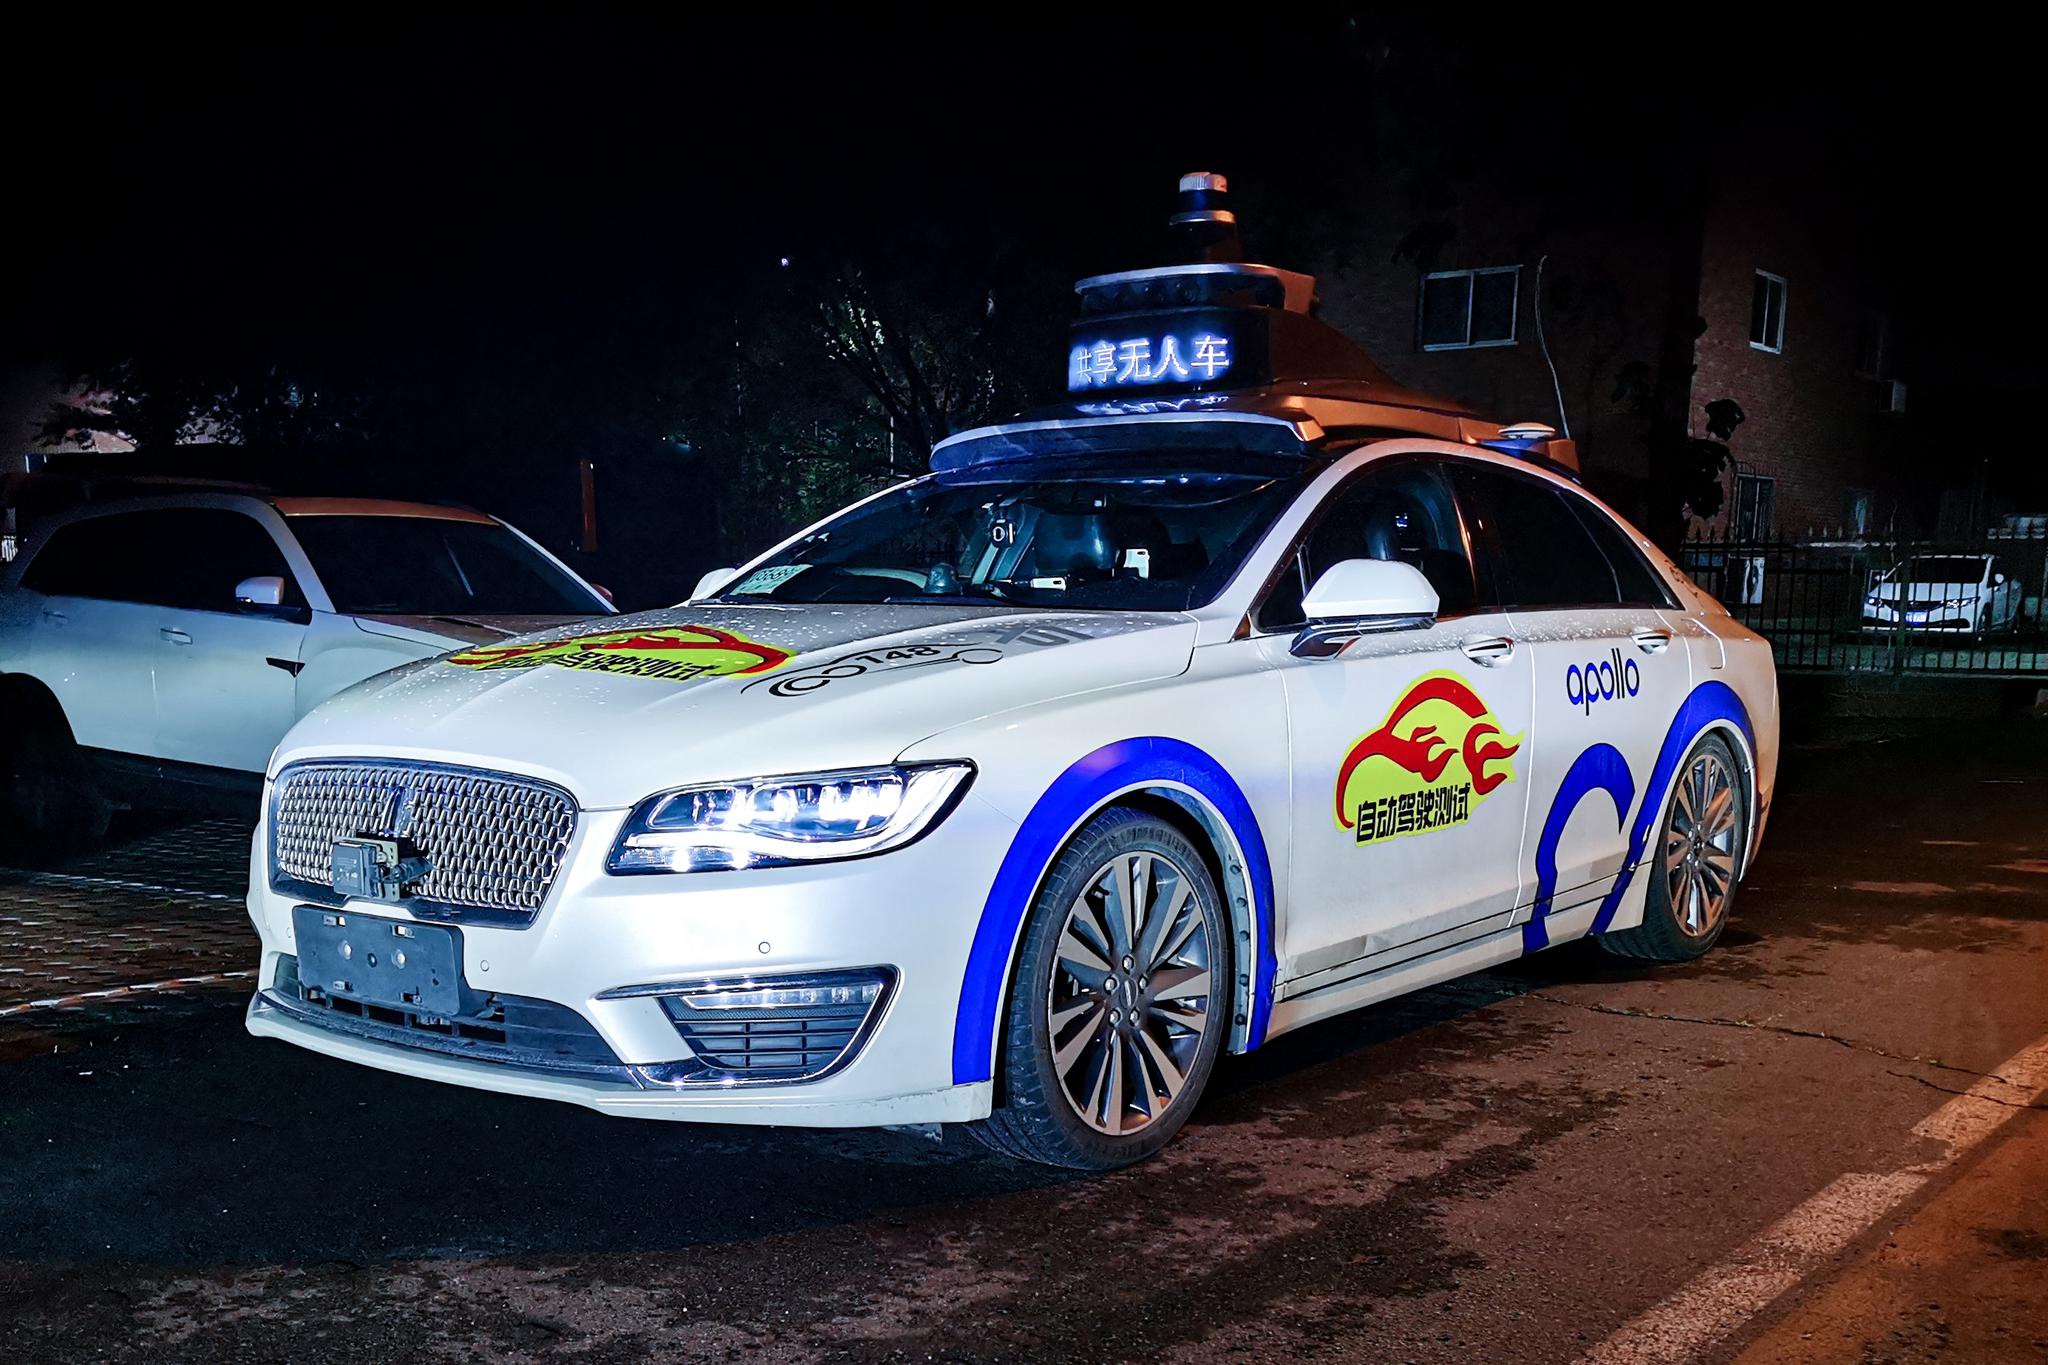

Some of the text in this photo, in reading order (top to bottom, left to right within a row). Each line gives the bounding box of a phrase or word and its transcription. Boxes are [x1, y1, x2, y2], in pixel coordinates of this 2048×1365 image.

[1076, 335, 1230, 383] 共享无人车
[855, 646, 941, 665] 148
[1566, 648, 1640, 716] apollo
[1356, 782, 1471, 843] 自动驾驶测试
